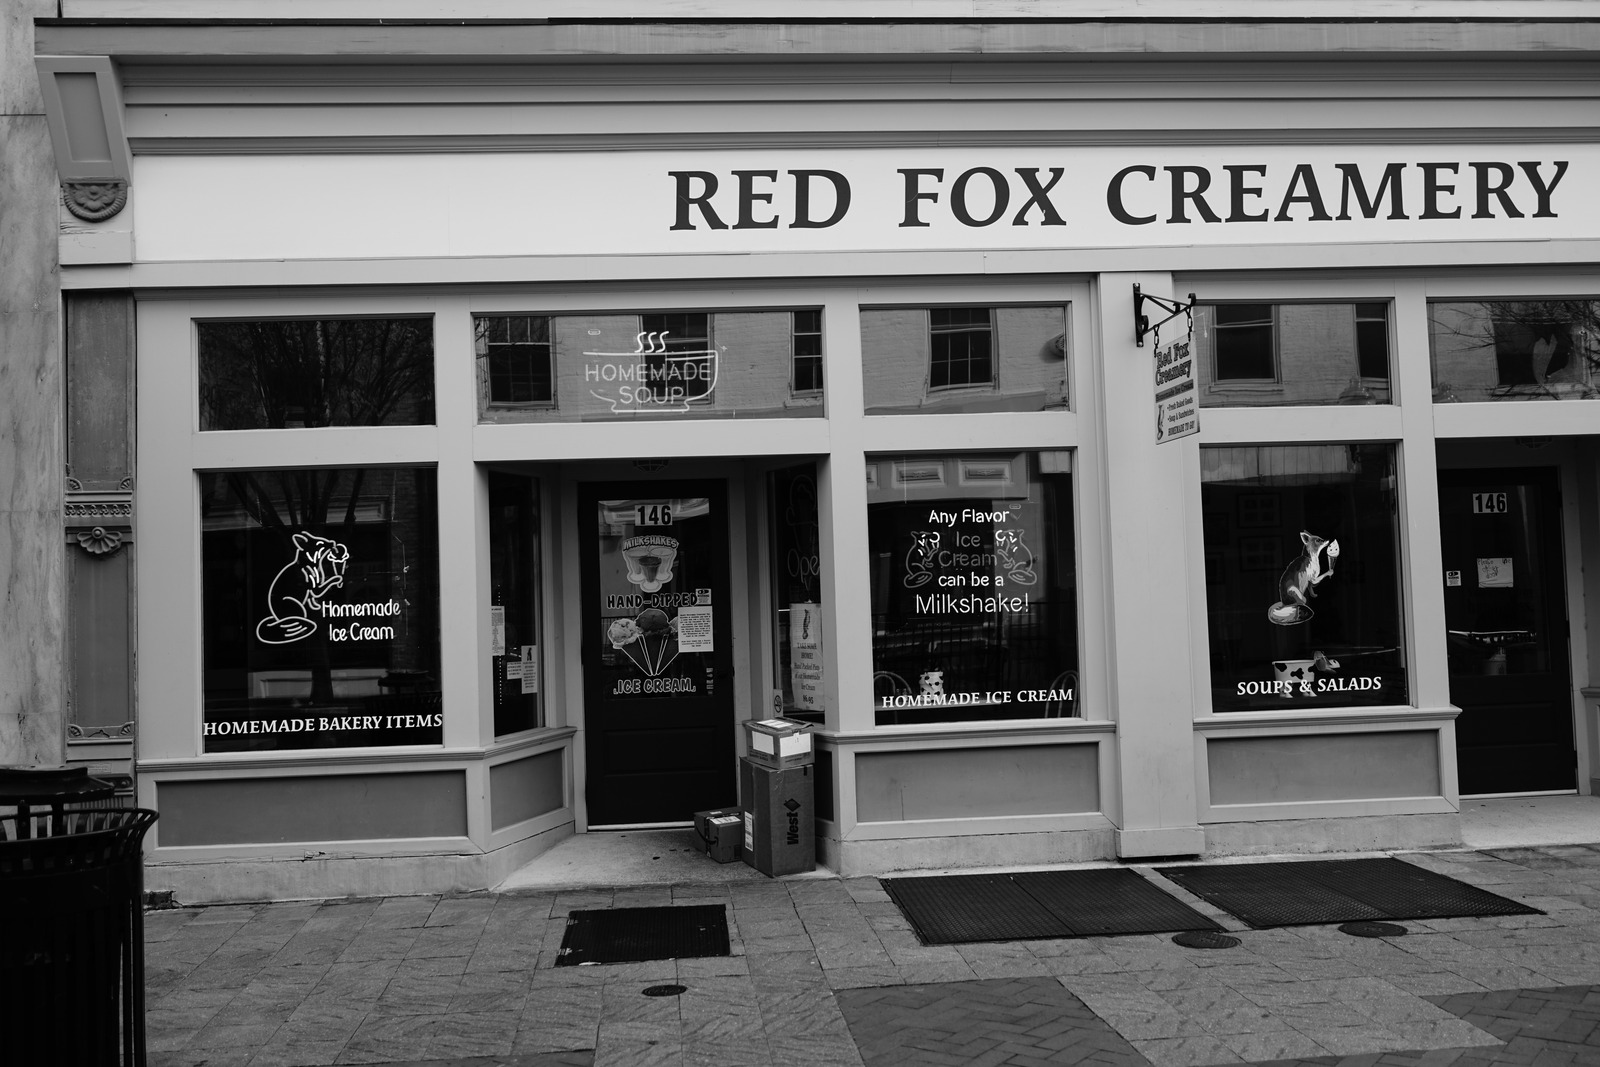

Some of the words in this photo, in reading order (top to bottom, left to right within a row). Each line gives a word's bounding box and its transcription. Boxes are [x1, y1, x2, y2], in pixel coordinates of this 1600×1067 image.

[668, 170, 851, 231] RED
[897, 166, 1066, 227] FOX
[1106, 160, 1569, 226] CREAMERY
[1156, 347, 1172, 369] Red
[1173, 342, 1190, 362] Fox
[585, 362, 711, 382] HOMEMADE
[1155, 360, 1192, 386] Creamery
[619, 386, 684, 404] SOUP
[1475, 493, 1506, 513] 146
[637, 505, 671, 525] 146
[928, 509, 958, 528] Any
[962, 509, 1010, 523] Flavor
[624, 536, 679, 551] MILKSHAKES
[956, 530, 981, 547] Ice
[787, 548, 820, 584] Ope
[938, 550, 998, 567] Cream
[938, 574, 966, 587] can
[971, 571, 990, 587] be
[994, 575, 1004, 587] a
[322, 598, 401, 617] Homemade
[607, 593, 698, 609] HAND-DIPPED
[916, 592, 1029, 614] Milkshake!
[329, 623, 348, 641] Ice
[350, 622, 394, 641] Cream
[618, 679, 641, 694] ICE
[643, 677, 692, 693] CREAM
[1237, 679, 1293, 695] SOUPS
[1299, 679, 1311, 693] &
[1317, 676, 1382, 692] SALADS
[882, 692, 980, 708] HOMEMADE
[986, 690, 1012, 704] ICE
[1017, 688, 1073, 702] CREAM
[203, 718, 315, 736] HOMEMADE
[319, 715, 383, 731] BAKERY
[386, 713, 443, 729] ITEMS
[786, 811, 799, 845] West
